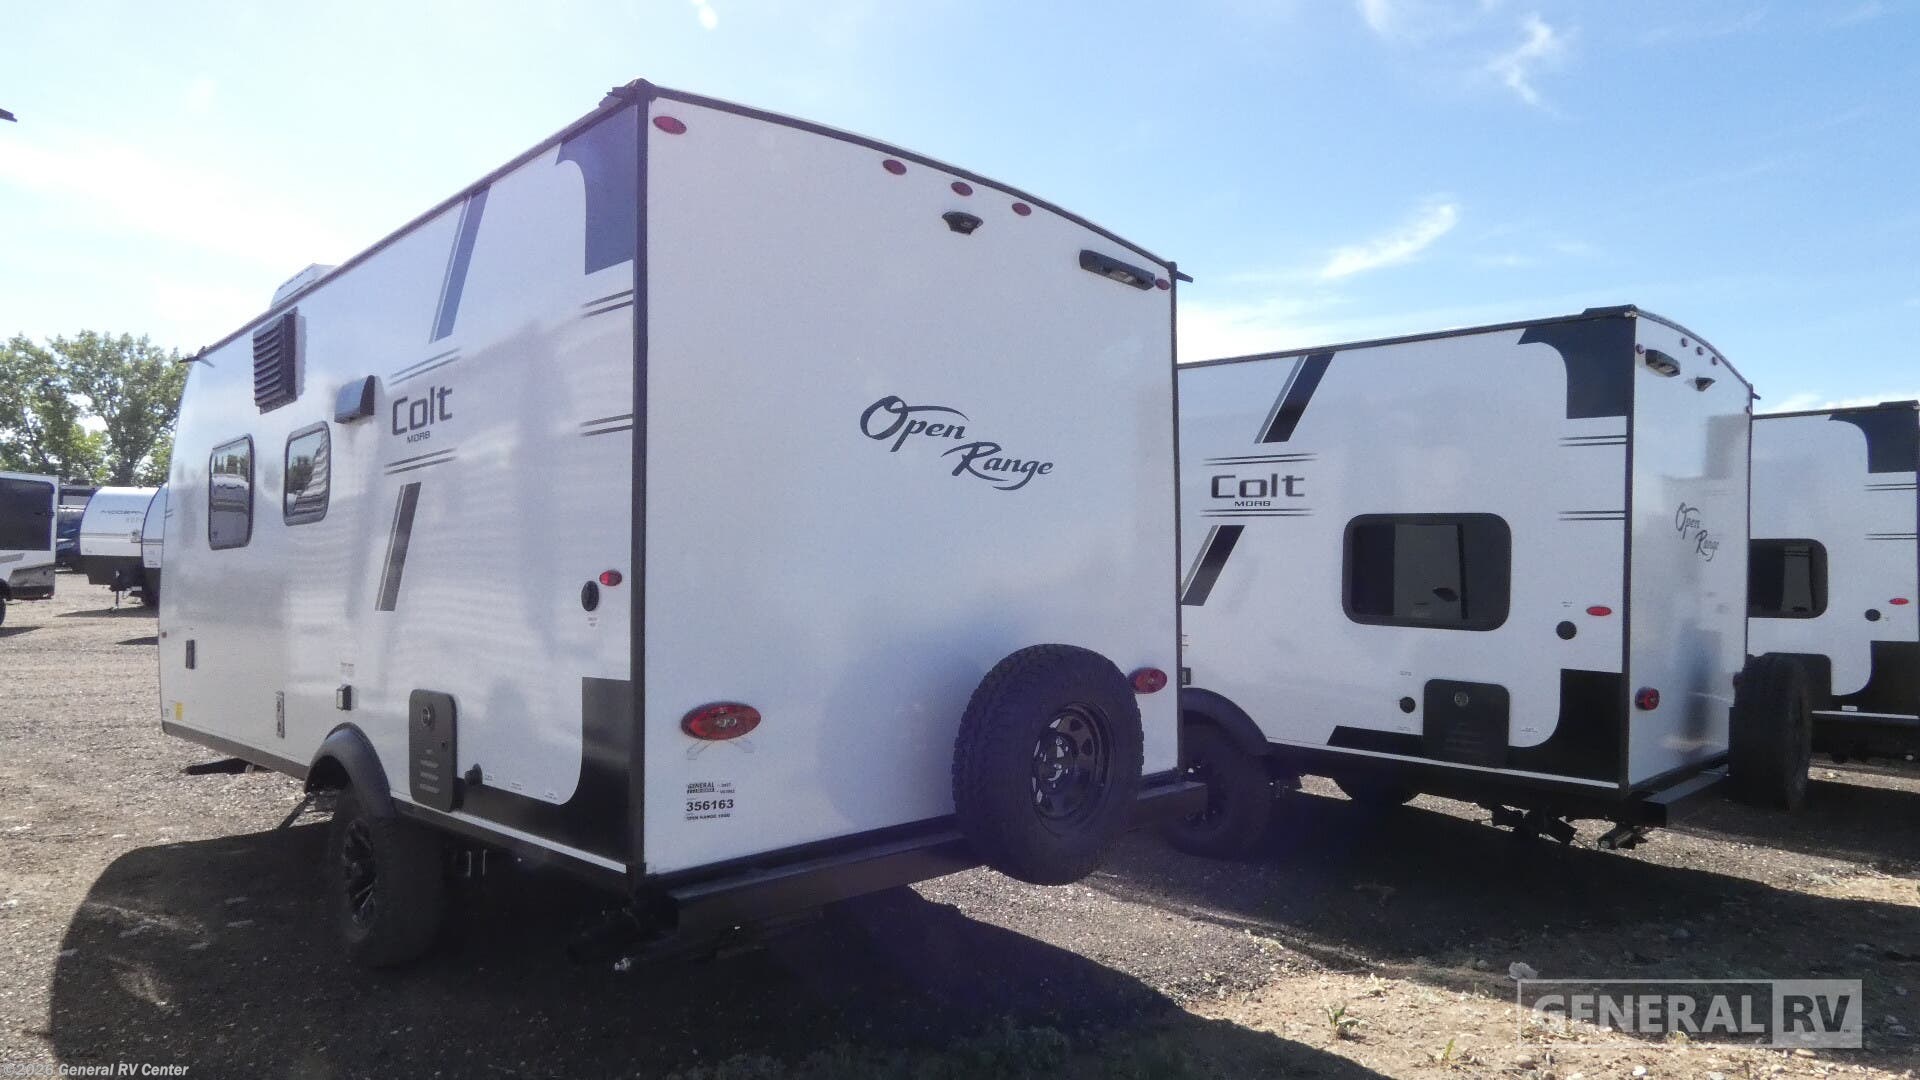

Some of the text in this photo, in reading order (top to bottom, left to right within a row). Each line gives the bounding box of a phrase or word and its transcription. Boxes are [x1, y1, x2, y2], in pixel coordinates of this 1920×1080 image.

[392, 386, 453, 436] Colt
[860, 395, 970, 453] Open
[940, 441, 1054, 491] Range
[1211, 473, 1305, 499] Colt
[686, 799, 734, 812] 356163
